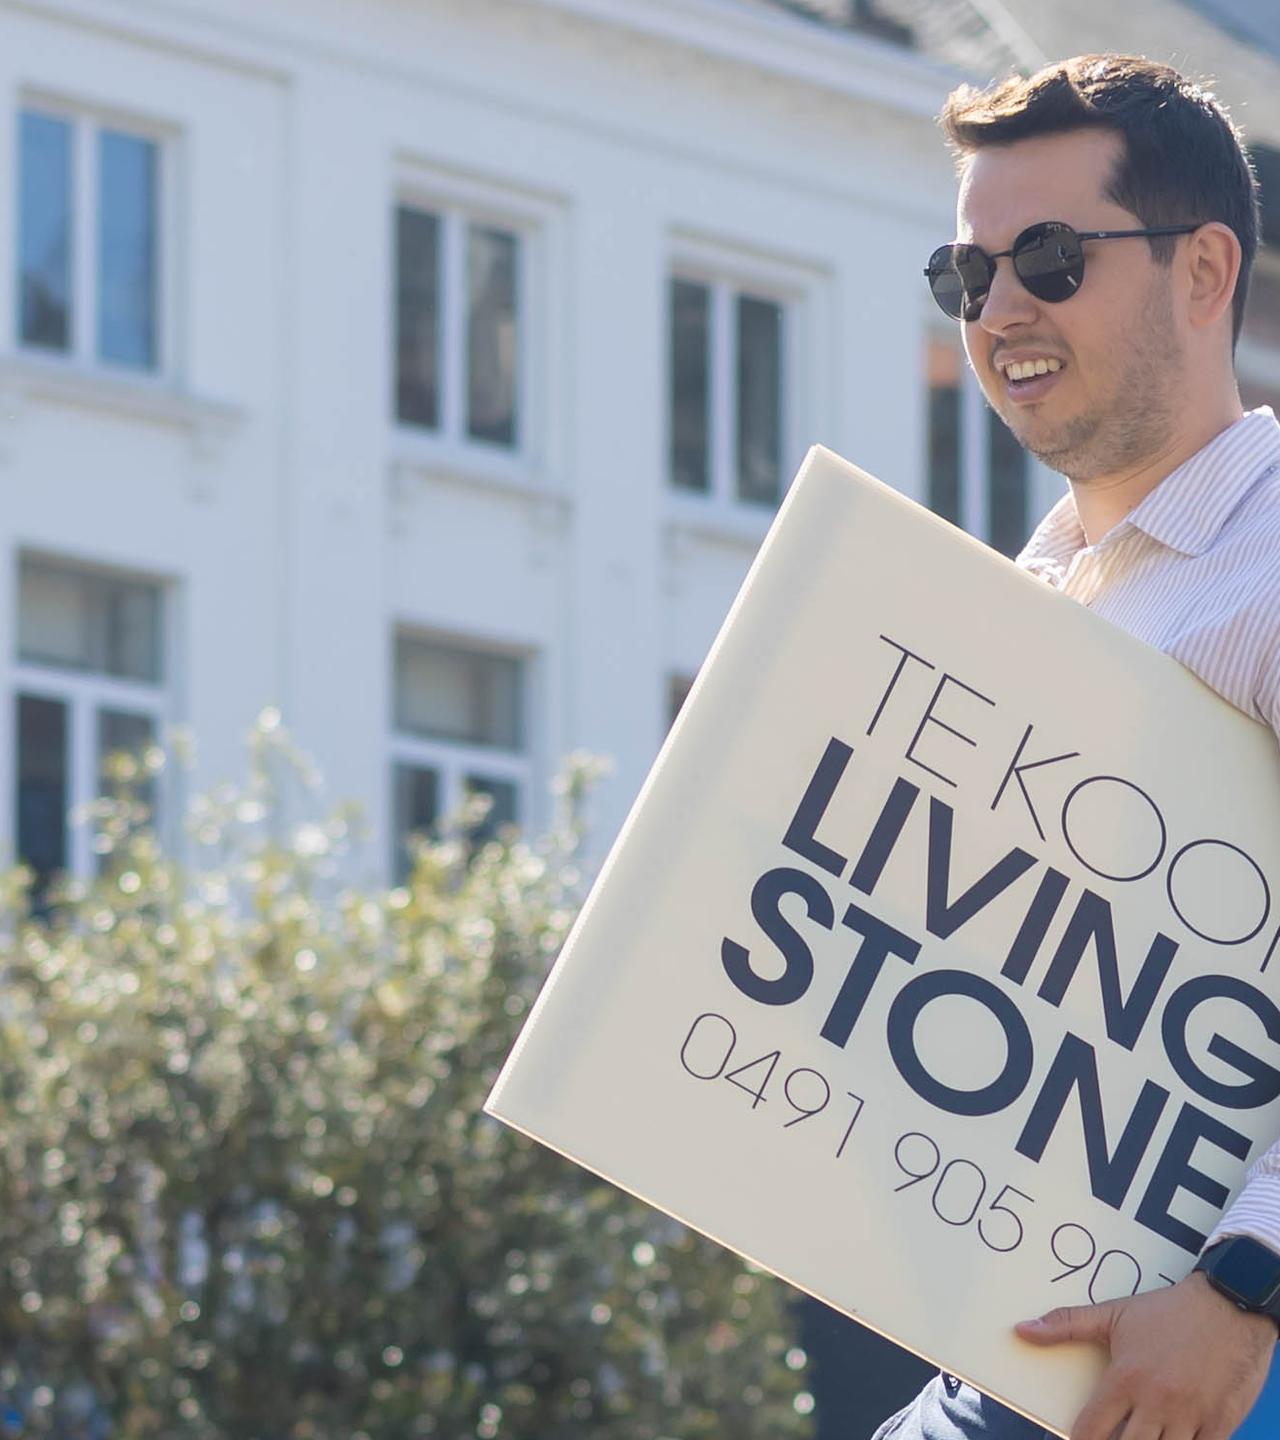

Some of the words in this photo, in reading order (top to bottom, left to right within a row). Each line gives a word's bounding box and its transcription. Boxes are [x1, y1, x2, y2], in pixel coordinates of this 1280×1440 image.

[866, 635, 996, 788] TE
[680, 1013, 864, 1158] 0491
[894, 1132, 1034, 1252] 905
[1051, 1223, 1176, 1306] 90
[721, 867, 1253, 1257] STONE
